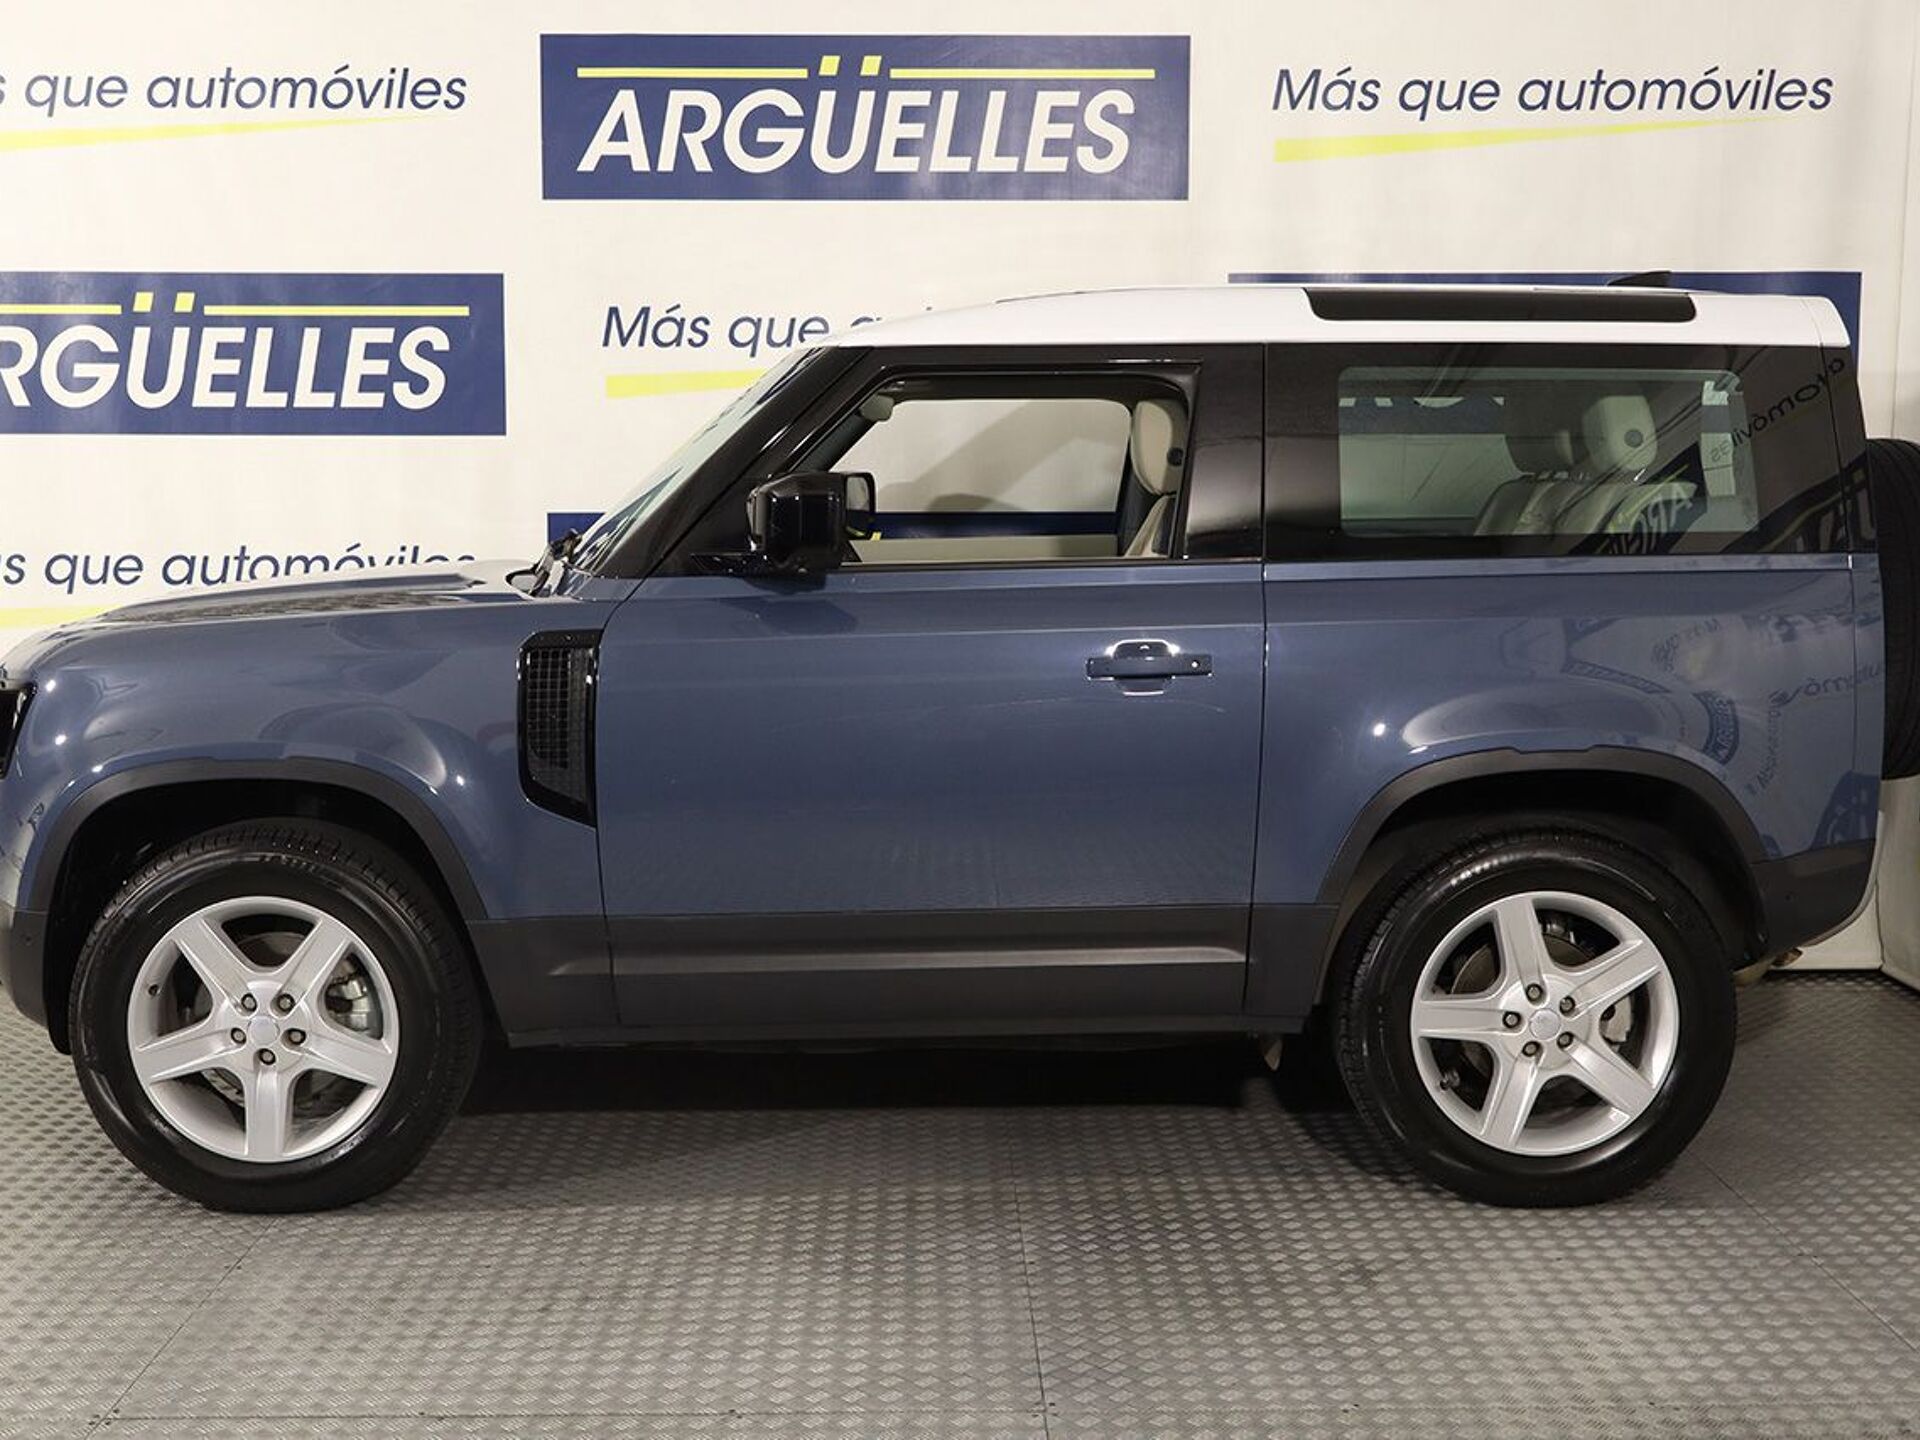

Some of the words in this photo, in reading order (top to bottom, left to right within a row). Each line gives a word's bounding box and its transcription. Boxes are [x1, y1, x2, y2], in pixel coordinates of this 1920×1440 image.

[26, 75, 128, 117] que
[147, 64, 467, 110] automóviles
[576, 55, 1135, 174] ARGÜELLES
[1272, 66, 1381, 112] Más
[1398, 79, 1501, 121] que
[1518, 66, 1834, 112] automóviles
[602, 304, 711, 348] Más
[728, 317, 830, 358] que
[44, 554, 144, 595] que
